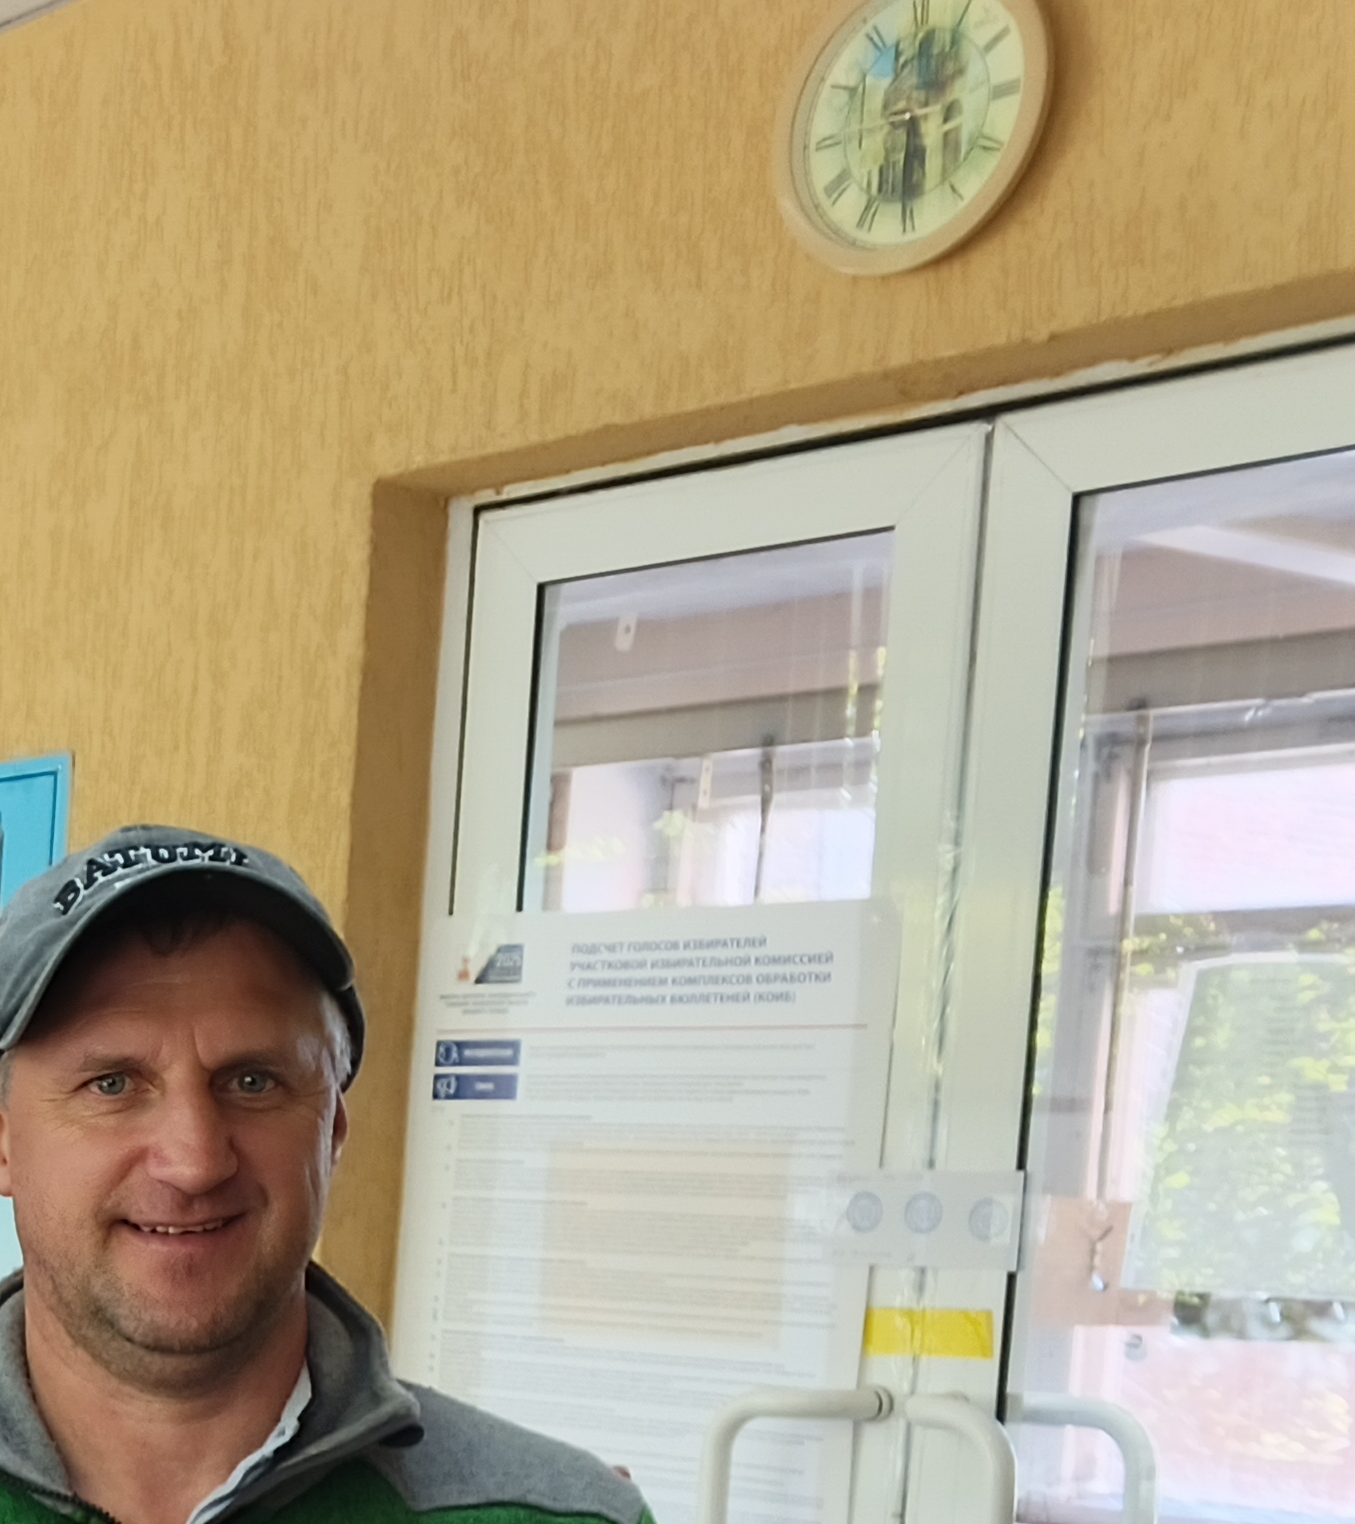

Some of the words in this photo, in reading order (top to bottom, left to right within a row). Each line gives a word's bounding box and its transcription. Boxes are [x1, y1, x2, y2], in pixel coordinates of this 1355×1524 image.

[571, 941, 624, 954] ПОДСЧЕТ
[626, 939, 680, 952] ГОЛОСОВ
[682, 935, 767, 951] ИЗБИРАТЕЛЕЙ
[569, 956, 648, 972] УЧАСТКОВОЙ
[650, 954, 752, 970] ИЗБИРАТЕЛЬНОЙ
[754, 950, 834, 967] КОМИССИЕЙ
[567, 976, 575, 989] С
[577, 975, 669, 989] ПРИМЕНЕНИЕМ
[671, 973, 753, 988] КОМПЛЕКСОВ
[755, 971, 833, 985] ОБРАБОТКИ
[565, 993, 667, 1007] ИЗБИРАТЕЛЬНЫХ
[669, 990, 751, 1006] БЮЛЛЕТЕНЕЙ
